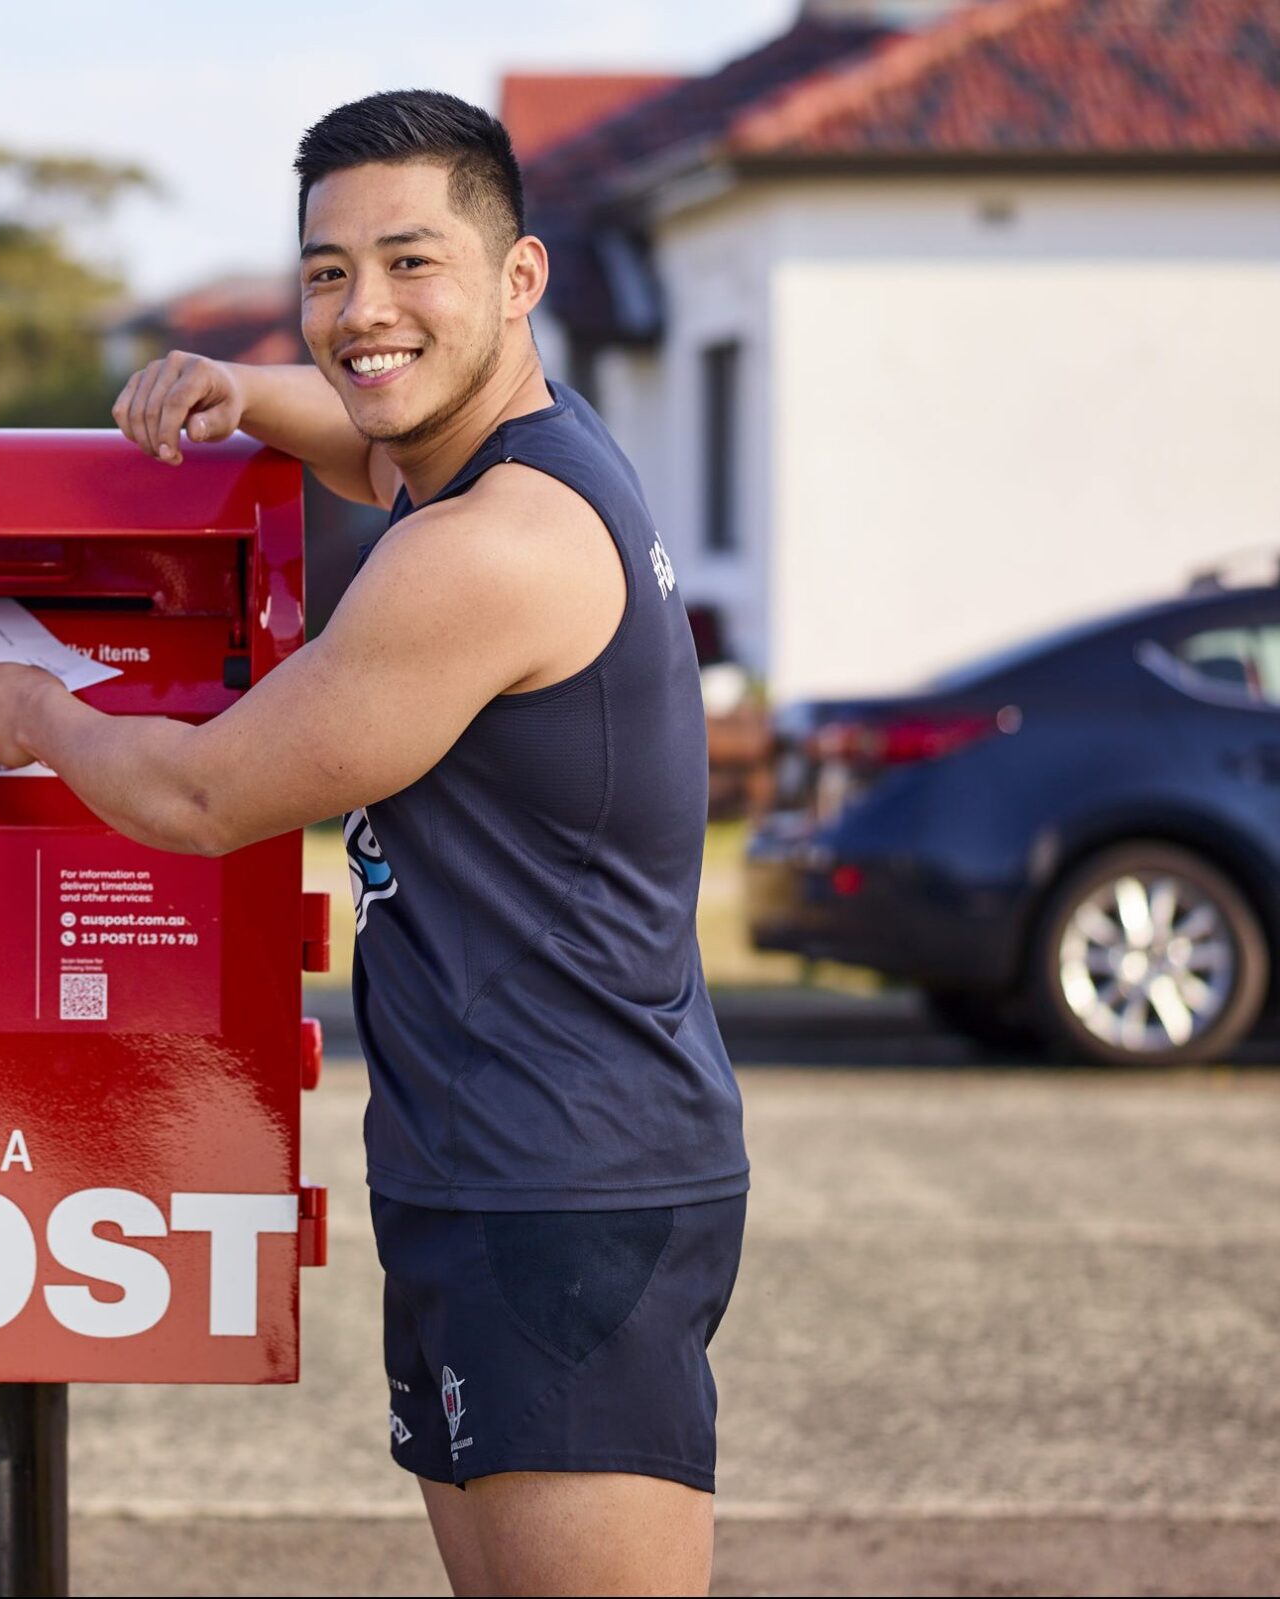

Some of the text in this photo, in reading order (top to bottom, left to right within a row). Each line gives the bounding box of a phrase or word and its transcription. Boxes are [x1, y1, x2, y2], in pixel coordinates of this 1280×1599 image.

[99, 644, 151, 662] items
[60, 869, 150, 879] For information on
[60, 882, 153, 892] delivery timetables
[60, 893, 153, 902] and other services:
[80, 914, 186, 927] auspost.com.au
[81, 933, 199, 946] 13 POST (13 76 78)
